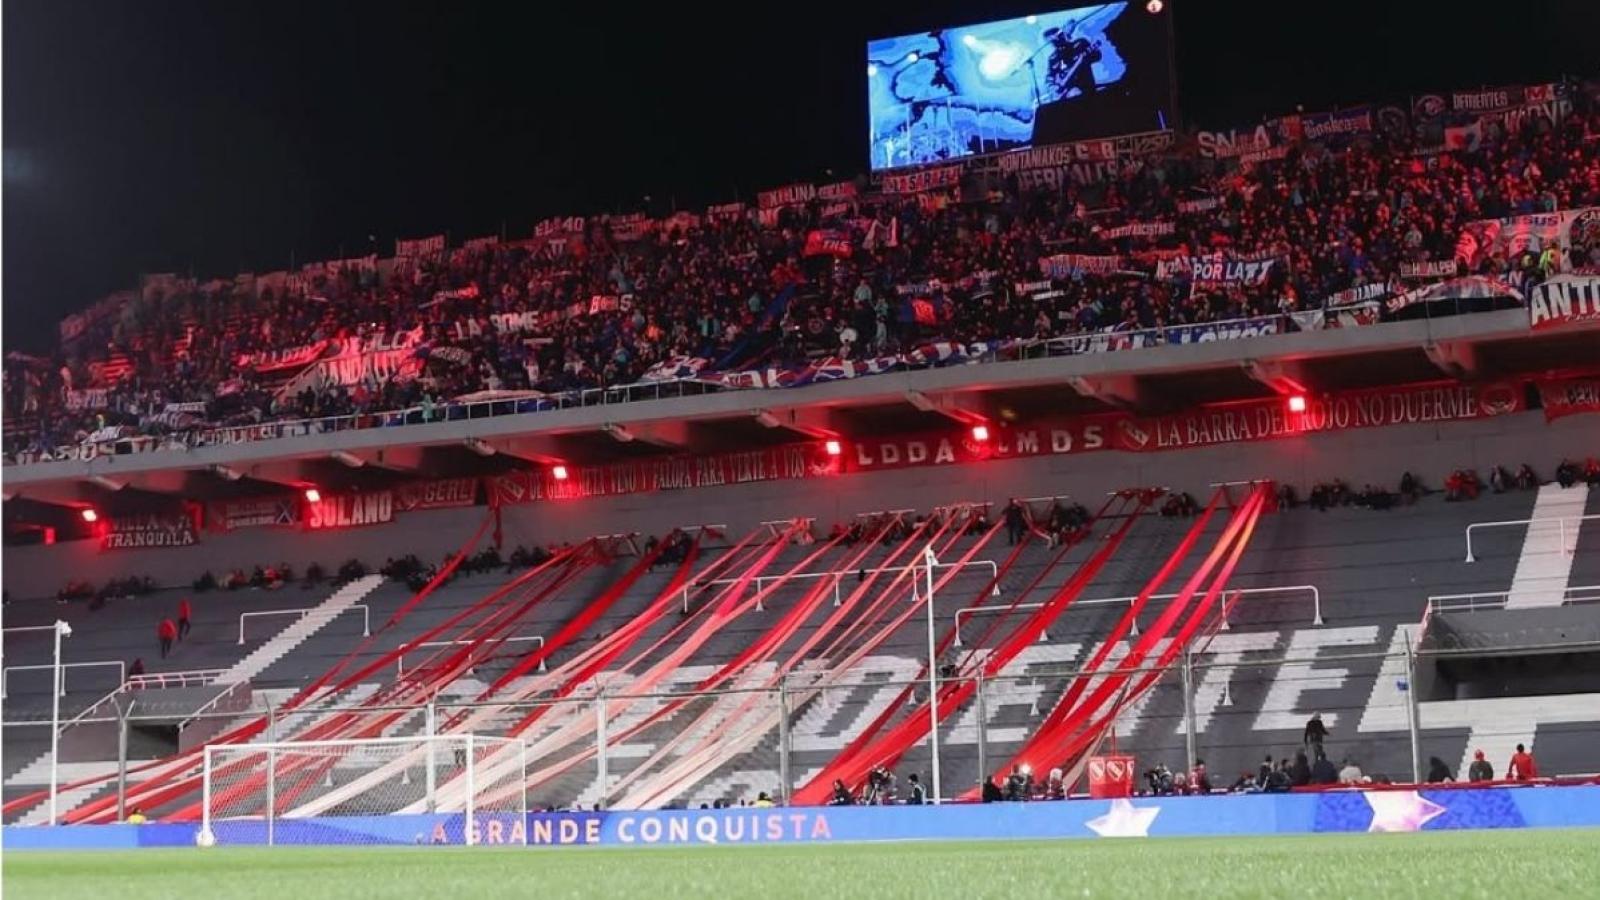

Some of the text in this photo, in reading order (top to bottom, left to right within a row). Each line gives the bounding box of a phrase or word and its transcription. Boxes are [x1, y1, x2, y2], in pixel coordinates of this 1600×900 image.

[1193, 263, 1222, 280] POR
[1157, 387, 1477, 447] LA BARRA DEL ROJO NO DUERME
[309, 490, 392, 527] SOLANO
[106, 530, 194, 548] TRANQUILA
[432, 814, 832, 844] A GRANDE CONQUISTA
